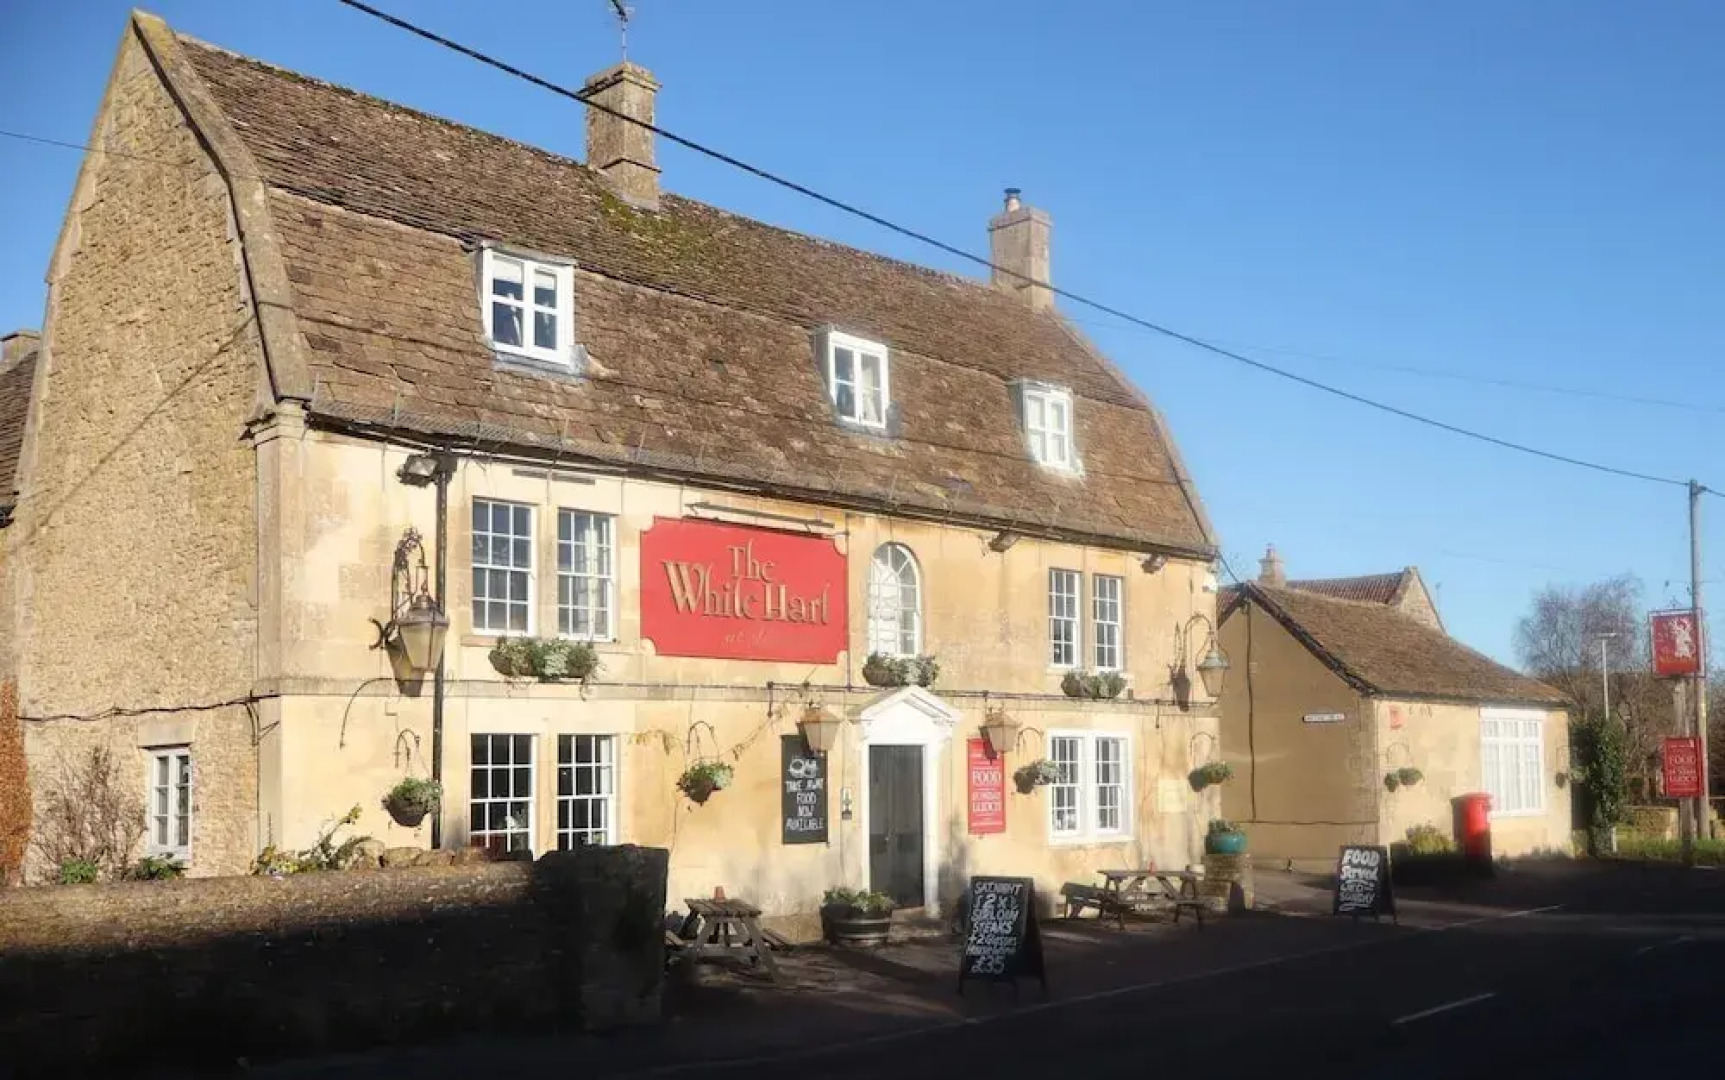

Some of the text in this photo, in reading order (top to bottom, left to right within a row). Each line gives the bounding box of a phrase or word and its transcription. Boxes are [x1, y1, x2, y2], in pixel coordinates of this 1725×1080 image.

[729, 538, 775, 582] The
[662, 560, 831, 625] White Hart
[972, 769, 1001, 785] FOOD
[796, 791, 817, 804] FOOD
[1342, 849, 1380, 867] FOOD
